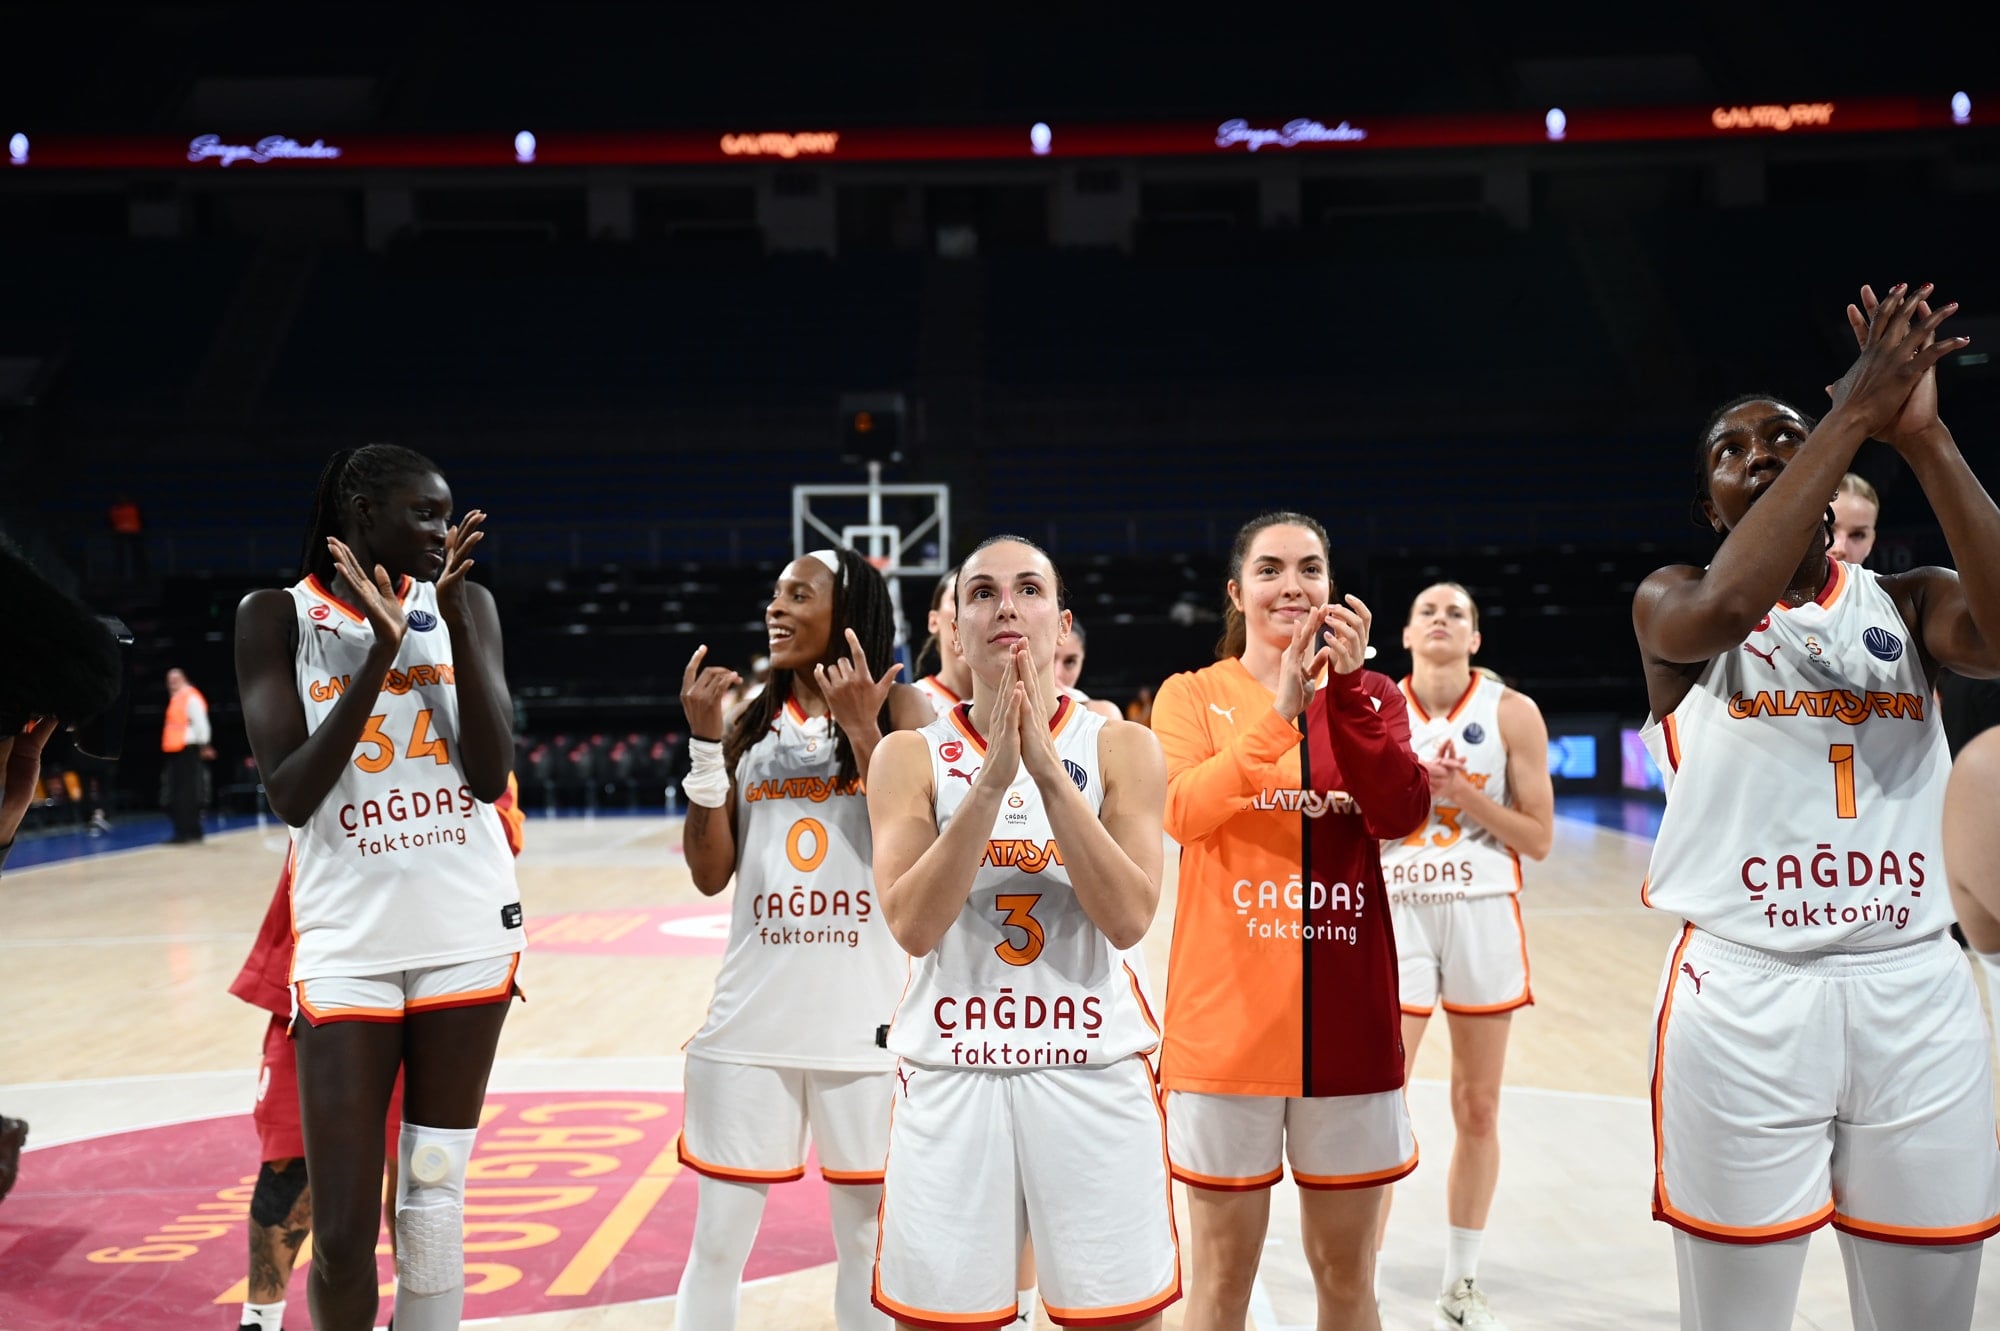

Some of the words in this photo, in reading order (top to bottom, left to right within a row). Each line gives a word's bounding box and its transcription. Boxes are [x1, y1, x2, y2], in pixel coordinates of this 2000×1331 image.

[1727, 690, 1924, 725] GALATASARAY
[354, 709, 449, 774] 34
[1828, 743, 1857, 819] 1
[339, 784, 474, 838] ÇAĞDAŞ
[358, 825, 466, 857] faktoring
[786, 817, 829, 873] 0
[1232, 874, 1365, 918] ÇAĞDAŞ
[1741, 843, 1926, 901] ÇAĞDAŞ
[753, 886, 872, 926] ÇAĞDAŞ
[994, 893, 1045, 967] 3
[1764, 897, 1910, 930] faktoring
[760, 925, 859, 948] faktoring
[1246, 918, 1357, 945] faktoring
[933, 987, 1104, 1039] ÇAĞDAŞ
